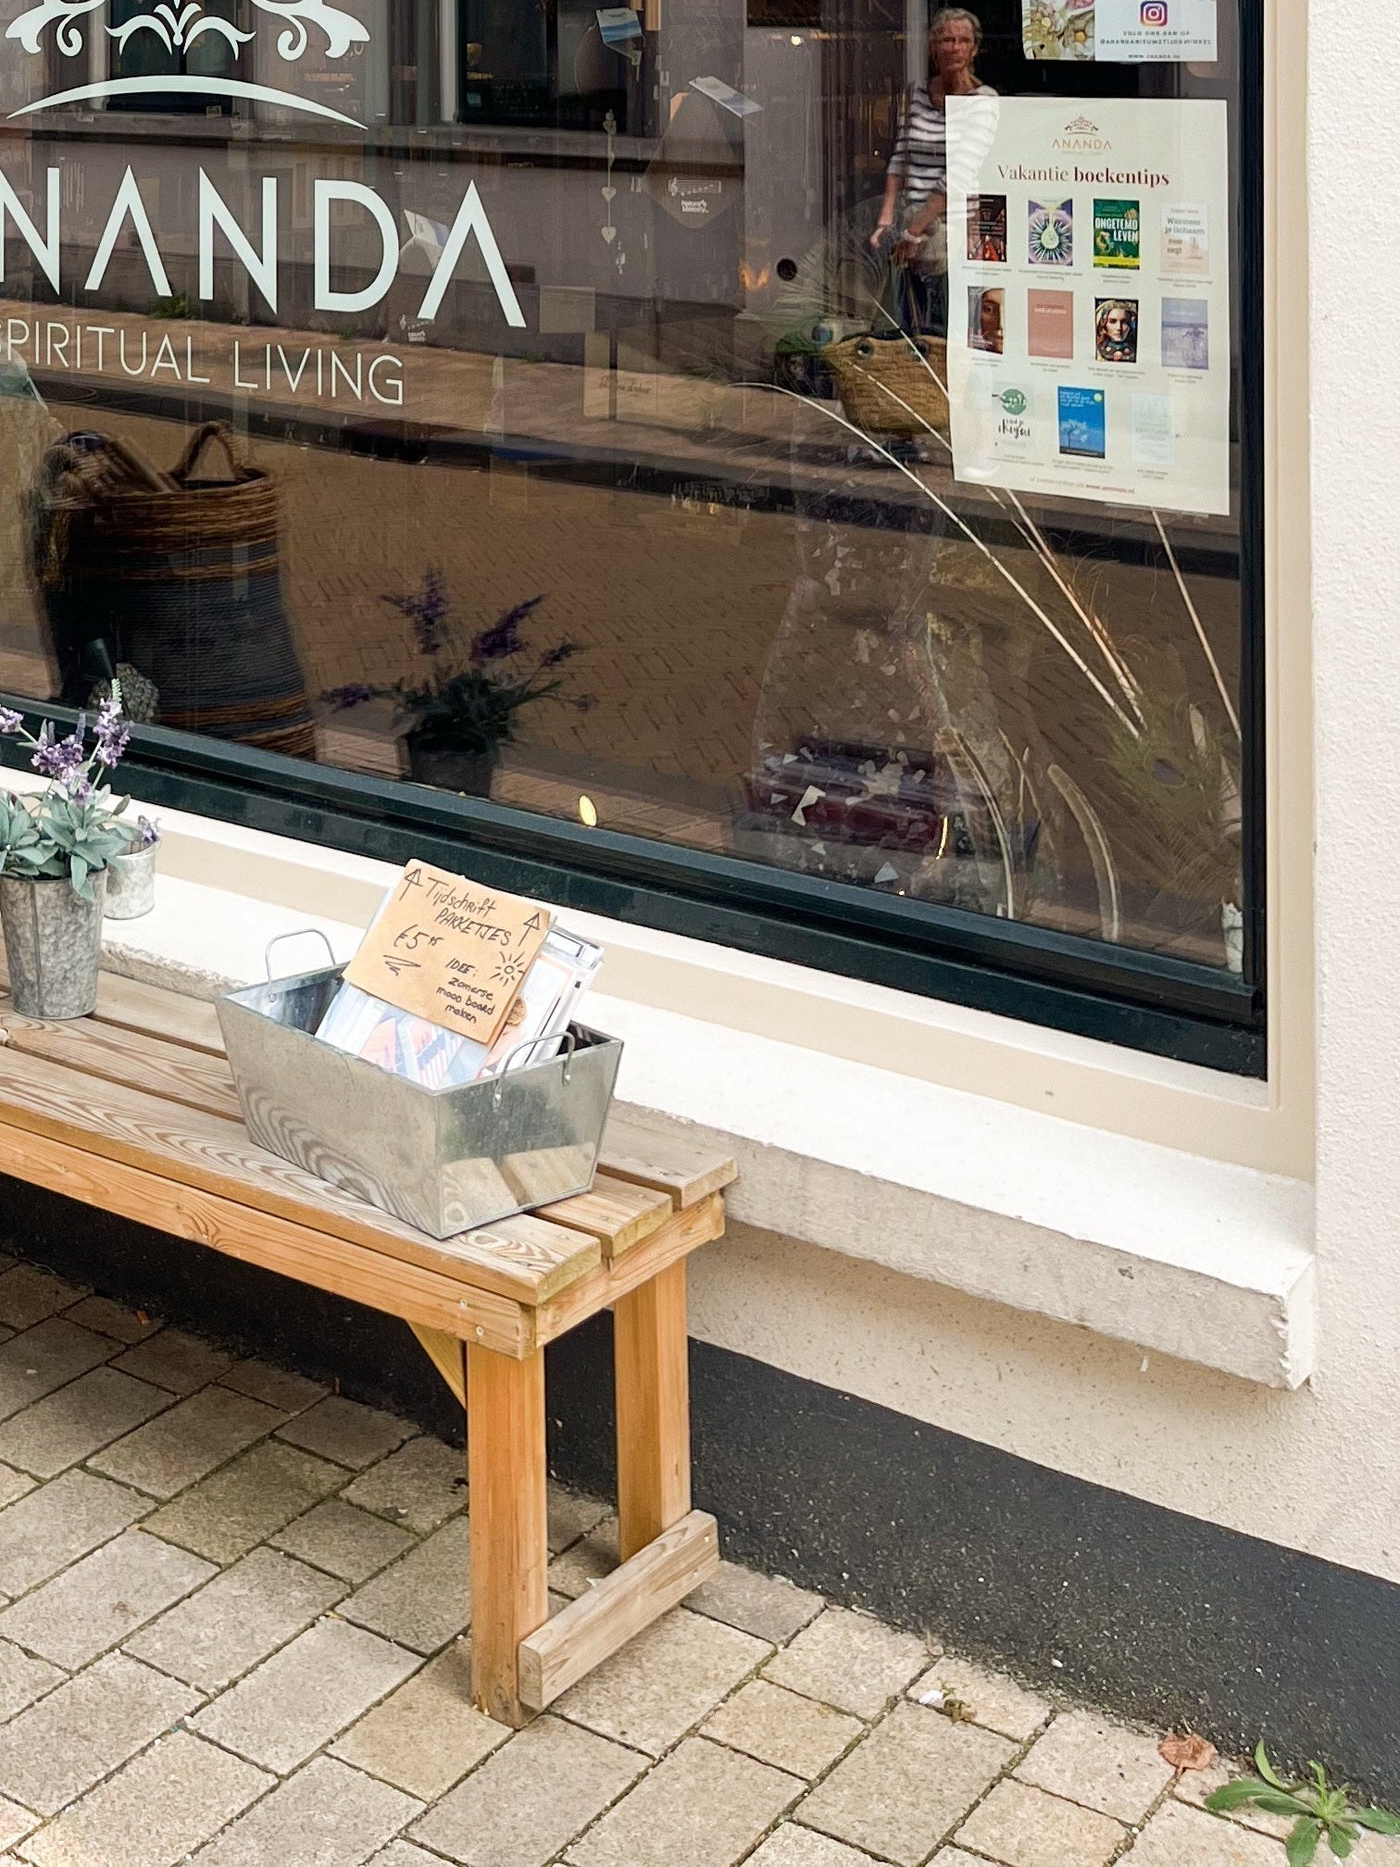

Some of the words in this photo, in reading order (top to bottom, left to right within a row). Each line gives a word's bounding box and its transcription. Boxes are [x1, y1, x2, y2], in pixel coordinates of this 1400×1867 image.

[1051, 138, 1113, 150] ANANDA
[998, 165, 1069, 182] Vakantie
[1074, 166, 1170, 188] boekentips
[1094, 217, 1138, 231] ONGETEMD
[1113, 229, 1139, 243] LEVEN
[234, 339, 404, 405] LIVING
[425, 876, 497, 918] Tijdschrift
[434, 907, 512, 947] PAKKETJES
[444, 1004, 477, 1024] maken
